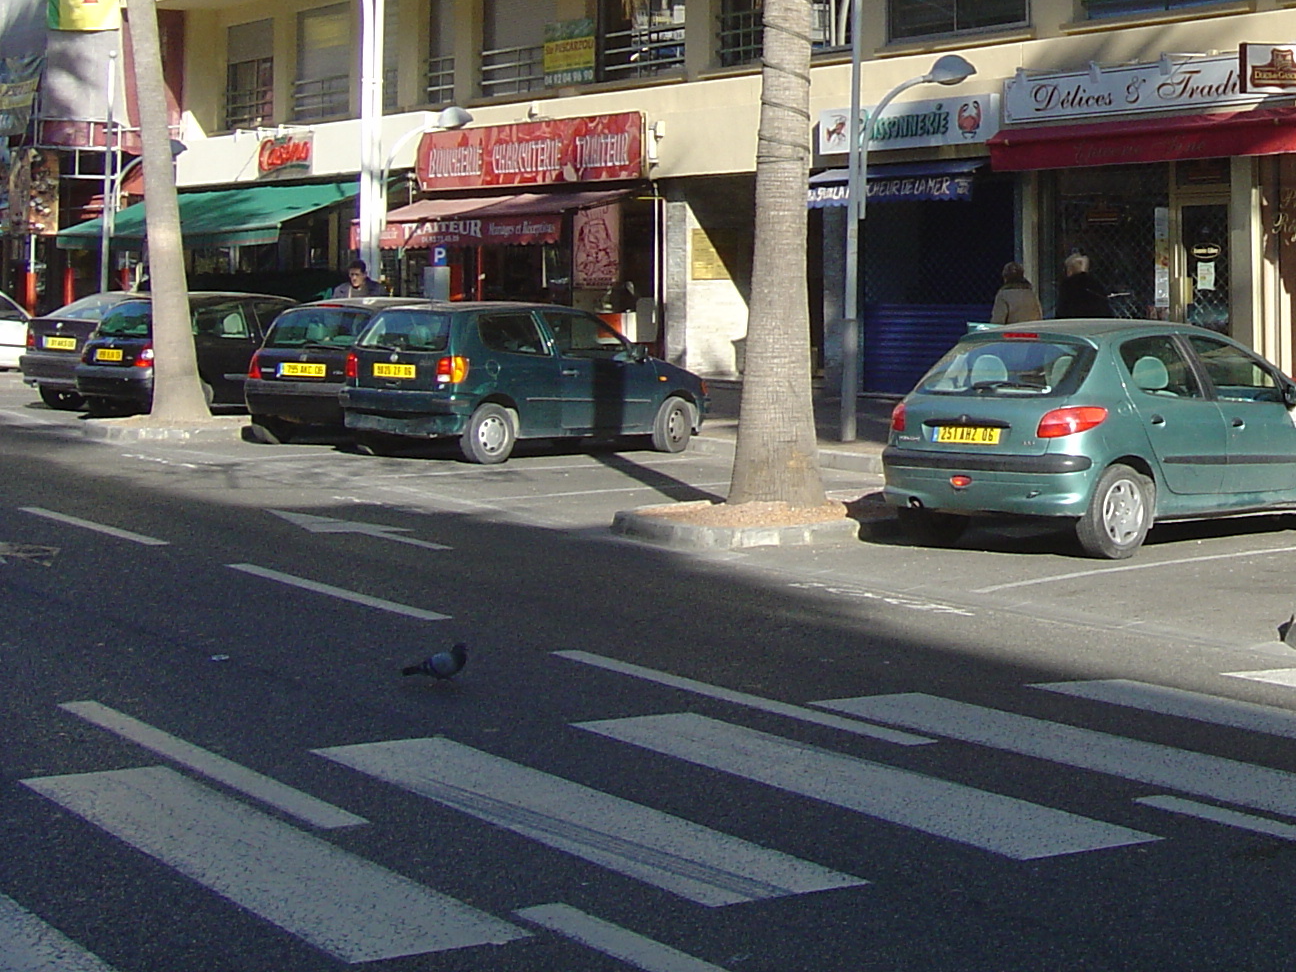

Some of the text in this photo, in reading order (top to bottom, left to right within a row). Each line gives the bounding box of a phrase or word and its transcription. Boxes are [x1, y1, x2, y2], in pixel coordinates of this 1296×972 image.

[1032, 83, 1114, 112] Délices
[1126, 77, 1146, 104] &
[859, 103, 950, 149] PISSONNERIE
[259, 136, 309, 172] Casino
[429, 132, 630, 178] BOUCHERIE CHARCUTERIE TRAITEUR
[927, 176, 950, 195] MER
[402, 219, 482, 240] TRAITEUR
[434, 247, 446, 263] P
[981, 429, 994, 441] 06
